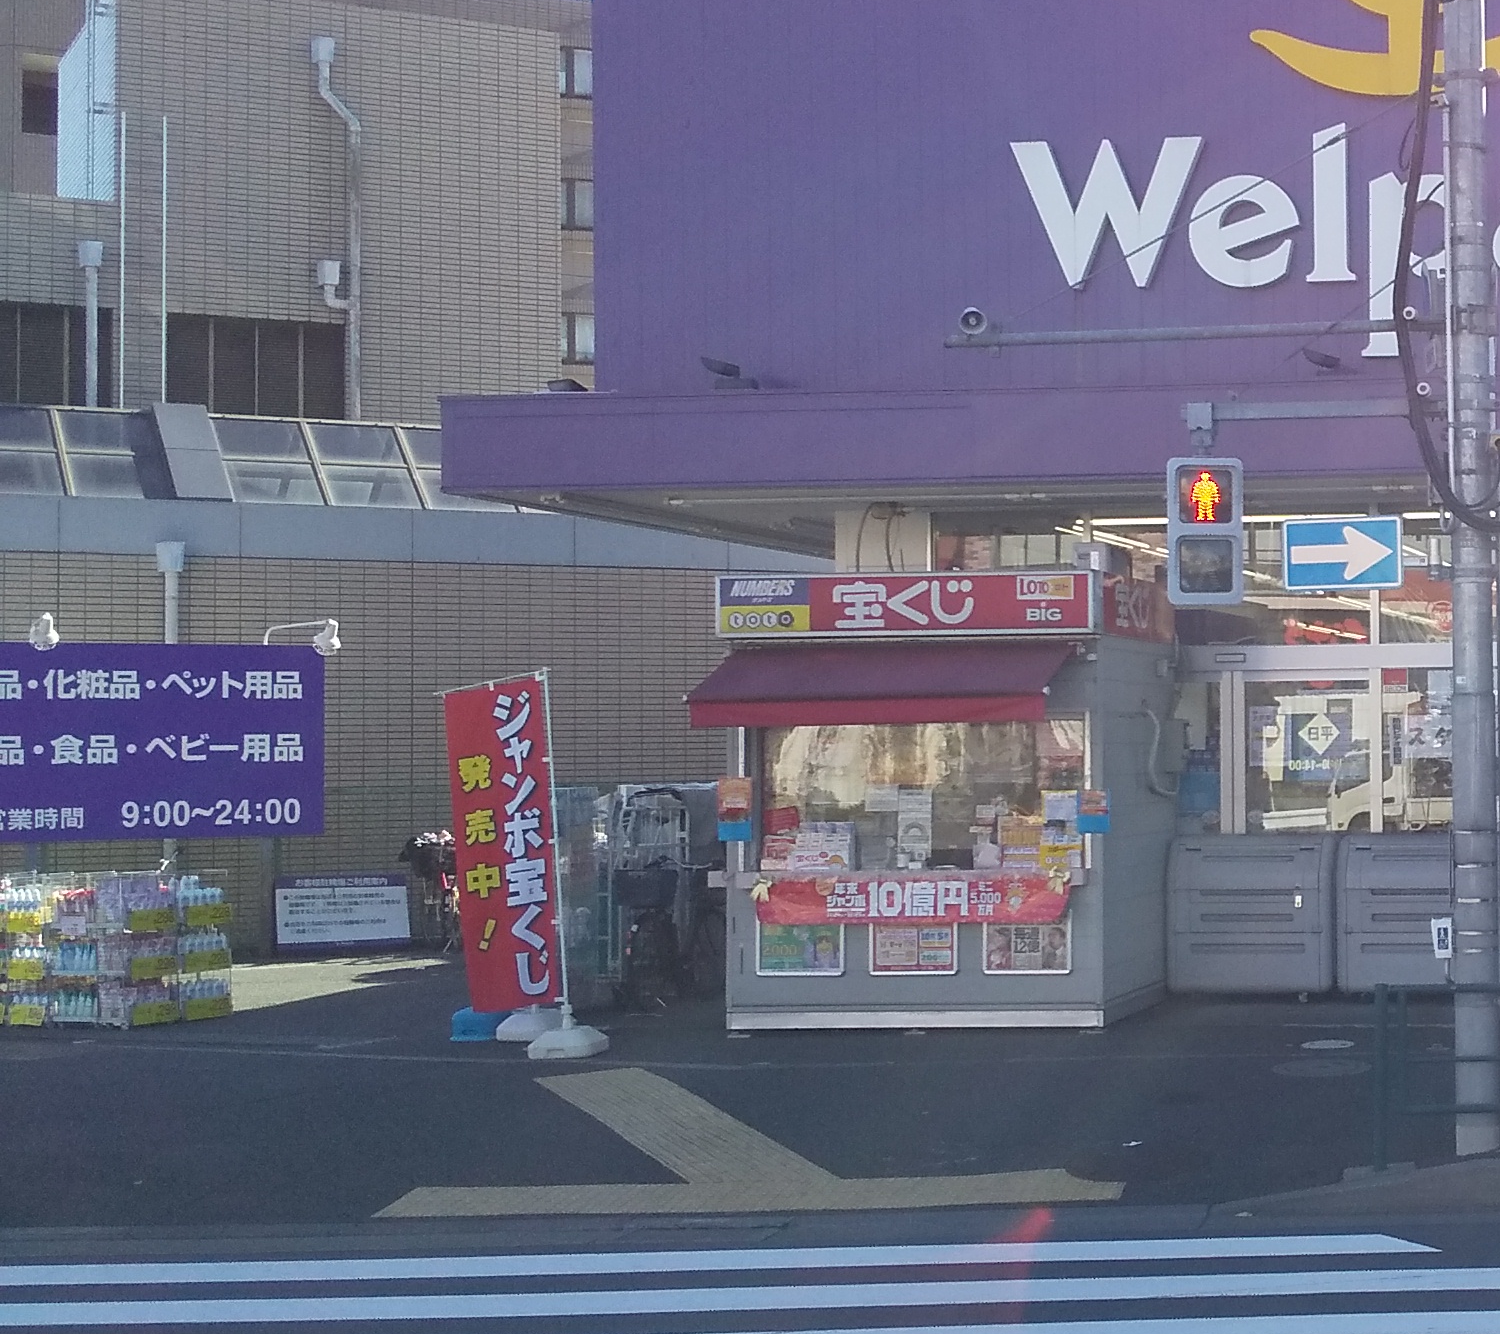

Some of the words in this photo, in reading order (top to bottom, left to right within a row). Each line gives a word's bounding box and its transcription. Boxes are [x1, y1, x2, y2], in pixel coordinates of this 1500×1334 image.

[730, 579, 795, 597] NUMBERS
[1019, 578, 1049, 596] LOTO
[833, 580, 973, 629] 宝くじ
[729, 611, 794, 629] toto
[0, 669, 302, 700] 品・化粧品・ペット用品
[0, 733, 303, 766] 品・食品・ベビー用品
[0, 807, 84, 832] 業時間
[493, 690, 550, 995] ジャンボ宝くじ
[834, 882, 858, 895] 年末
[867, 880, 970, 917] 10億円
[826, 895, 866, 908] ジャンボ
[1014, 940, 1040, 954] 12億
